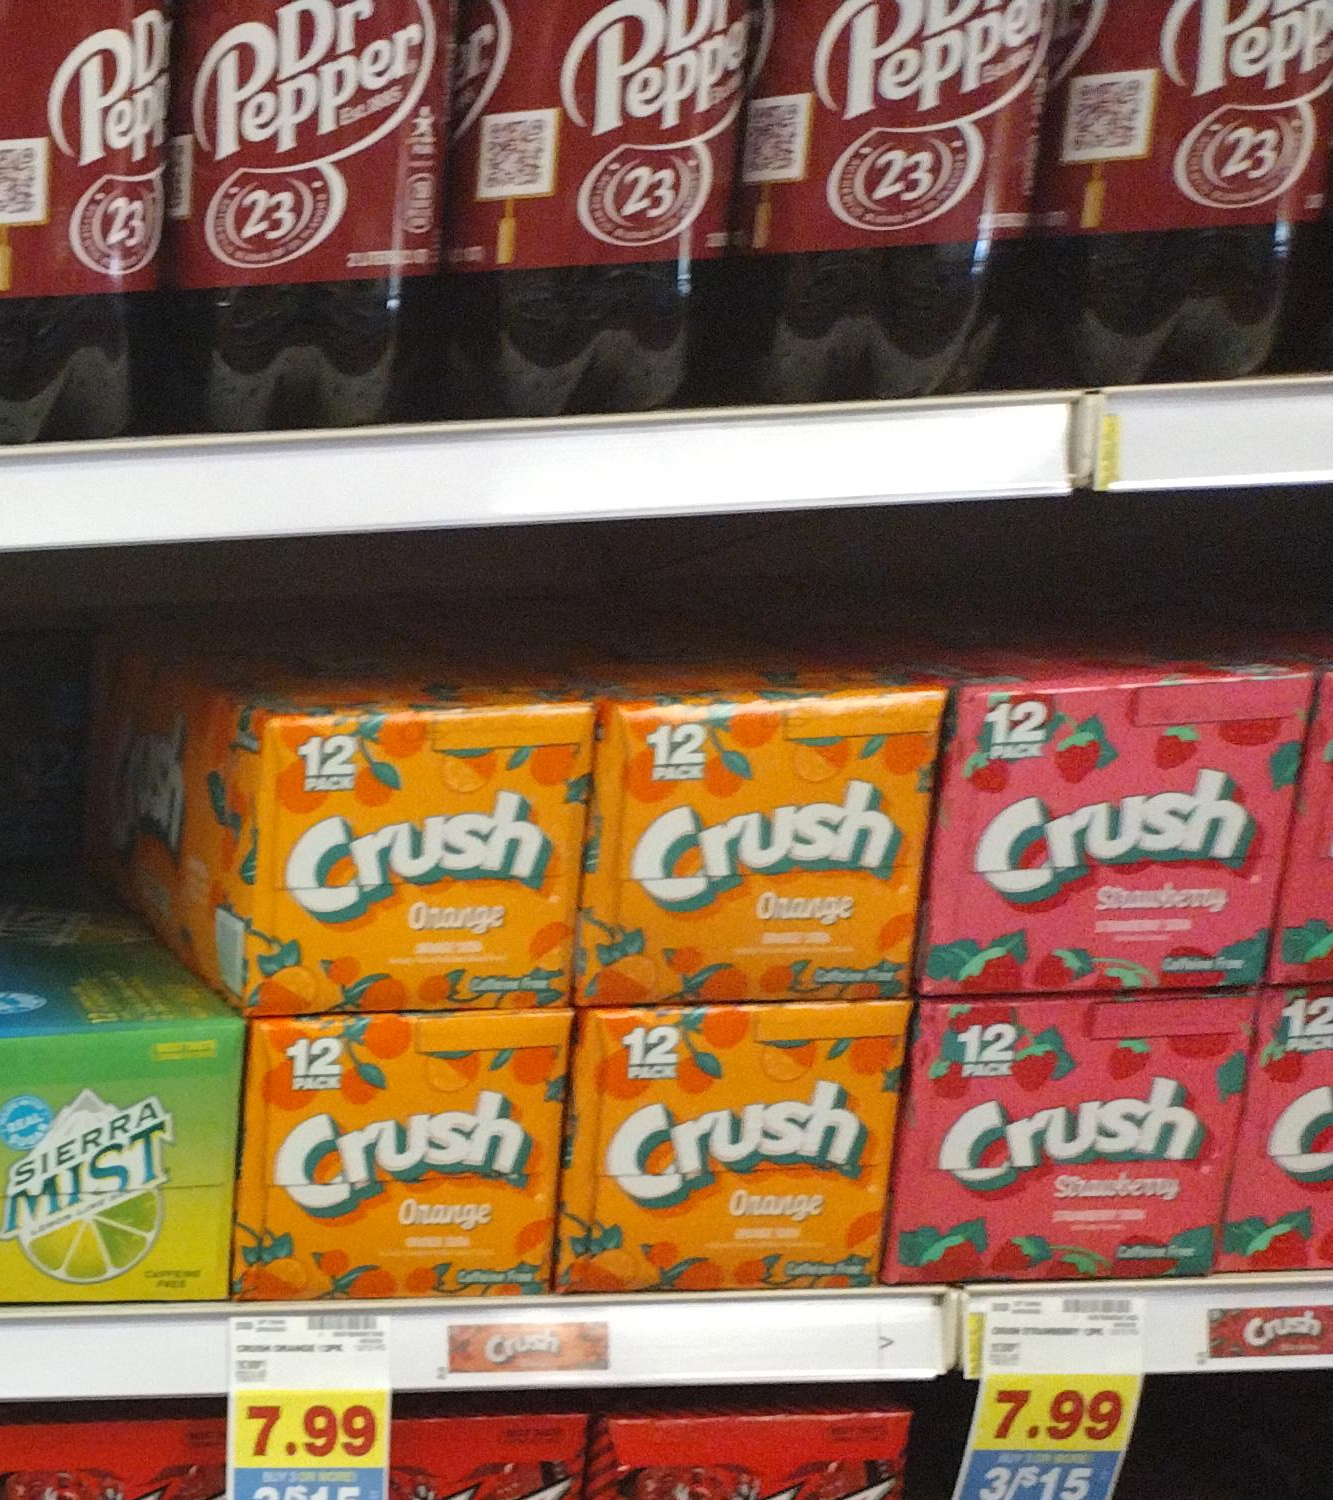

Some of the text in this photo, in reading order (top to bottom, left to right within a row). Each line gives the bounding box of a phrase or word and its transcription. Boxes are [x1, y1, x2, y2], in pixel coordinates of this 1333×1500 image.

[872, 148, 933, 202] 23
[240, 190, 296, 235] 23
[984, 701, 1049, 744] 12
[297, 735, 358, 775] 12
[286, 791, 549, 920] Crush
[633, 781, 895, 910] Crush
[974, 768, 1255, 903] Crush
[409, 902, 504, 933] Orange
[757, 893, 853, 926] Orange
[1095, 883, 1227, 913] Strawberry
[15, 1102, 158, 1185] SIERRA
[273, 1090, 528, 1217] Crush
[938, 1077, 1205, 1190] Crush
[5, 1121, 165, 1232] MIST
[1055, 1173, 1179, 1199] Strawberry
[484, 1329, 561, 1361] Crush
[1242, 1312, 1321, 1346] Crush
[246, 1405, 376, 1456] 7.99
[993, 1390, 1123, 1440] 7.99
